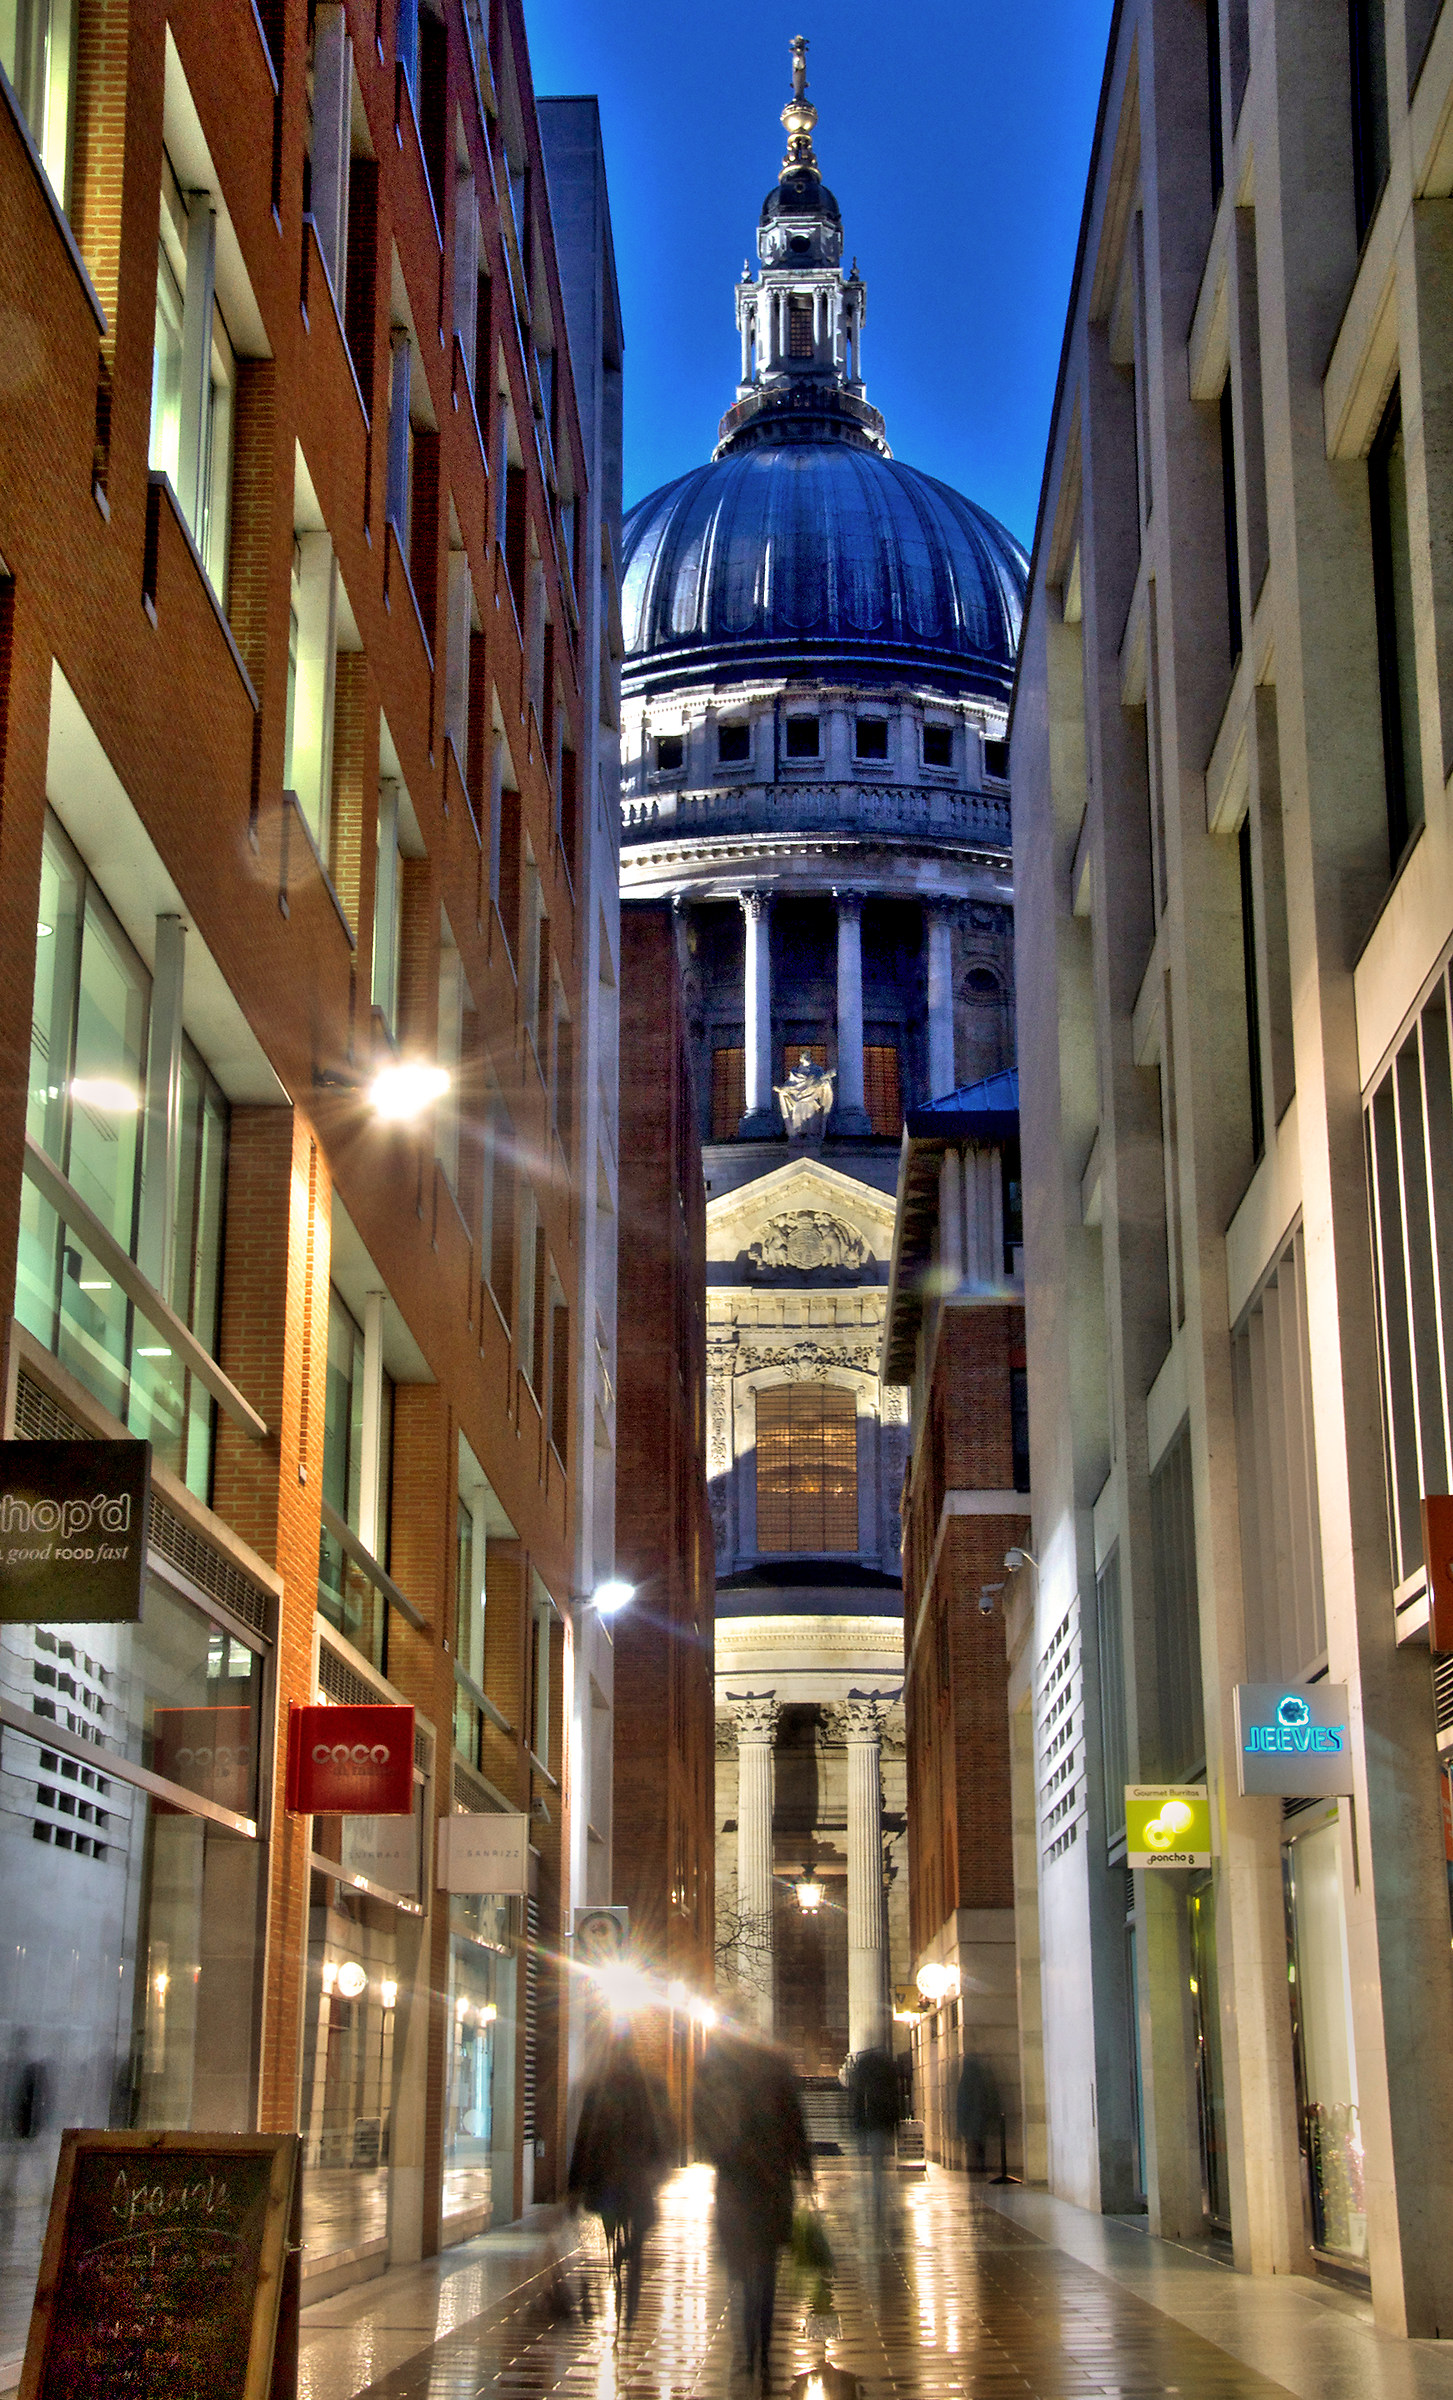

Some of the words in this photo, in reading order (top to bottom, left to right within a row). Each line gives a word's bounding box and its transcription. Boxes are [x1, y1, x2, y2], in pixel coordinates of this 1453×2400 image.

[0, 1493, 131, 1539] hop'd
[6, 1543, 53, 1565] good
[55, 1548, 94, 1560] FOOD
[92, 1542, 129, 1564] fast
[1244, 1726, 1343, 1752] JEEVES
[1133, 1788, 1168, 1797] Gourmet
[1169, 1788, 1200, 1797] Burritos
[466, 1850, 520, 1858] SANRIZZ
[1146, 1852, 1187, 1866] poncho
